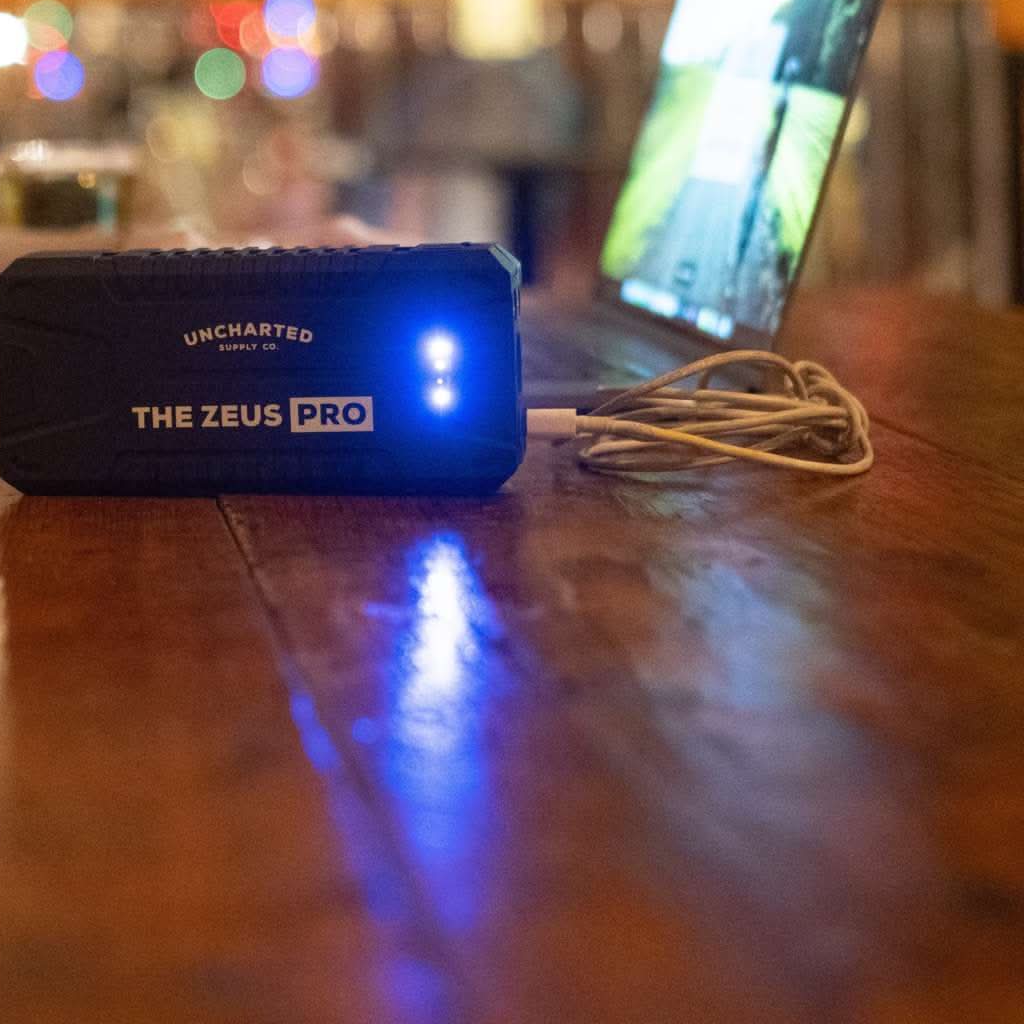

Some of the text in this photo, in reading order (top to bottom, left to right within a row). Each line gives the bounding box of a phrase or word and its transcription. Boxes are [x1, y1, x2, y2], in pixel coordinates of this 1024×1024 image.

[183, 322, 314, 347] UNCHARTED
[218, 342, 280, 352] SUPPLY CO.
[131, 402, 367, 429] THE ZEUS PRO
